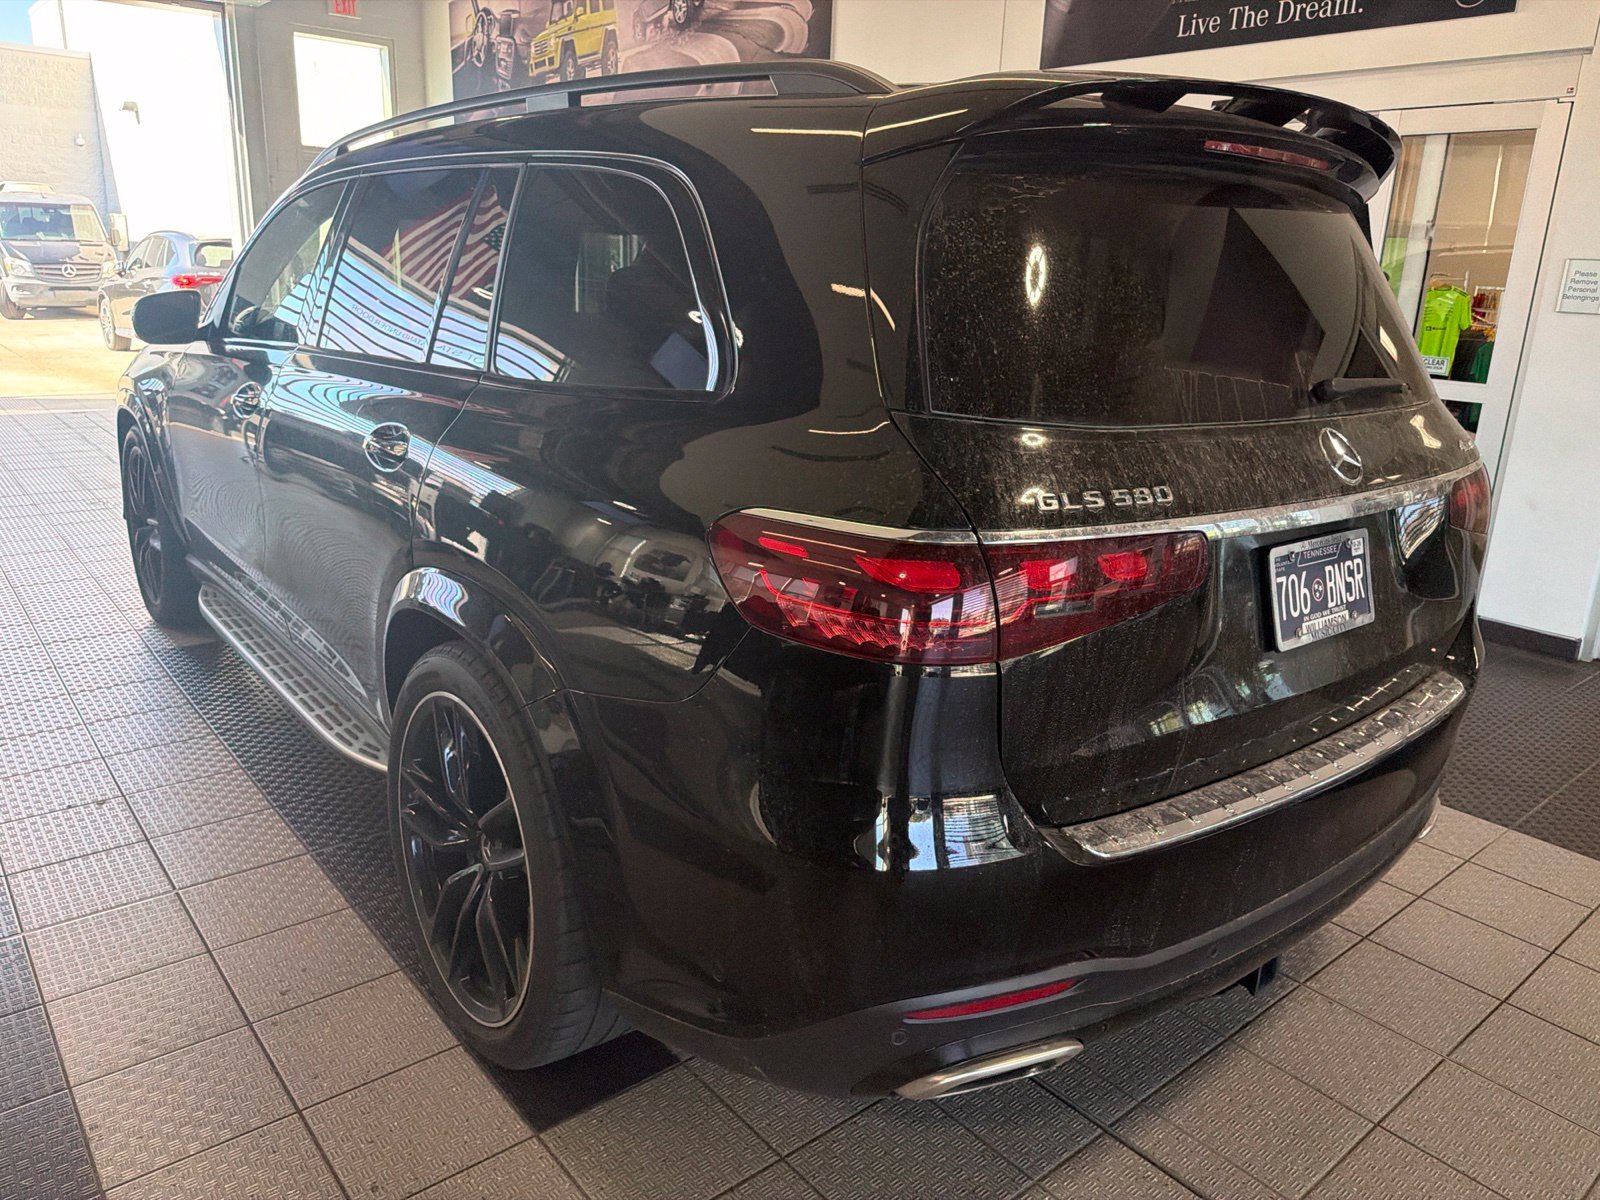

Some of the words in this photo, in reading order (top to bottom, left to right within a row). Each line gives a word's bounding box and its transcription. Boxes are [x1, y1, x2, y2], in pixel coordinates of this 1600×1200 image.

[1176, 15, 1221, 38] Live
[1228, 6, 1269, 31] The
[1275, 0, 1365, 25] Dream.
[1574, 270, 1598, 278] Please
[1570, 278, 1599, 286] Remove
[1562, 294, 1600, 303] Belongings
[1037, 490, 1105, 512] GLS
[1111, 485, 1174, 507] 580
[1303, 544, 1338, 559] TENNESSEE
[1276, 570, 1311, 621] 706
[1324, 558, 1365, 608] BNSR
[1310, 612, 1322, 620] GOD
[1322, 609, 1331, 617] WE
[1332, 605, 1347, 615] TRUST
[1304, 613, 1347, 634] WILLIAMSON
